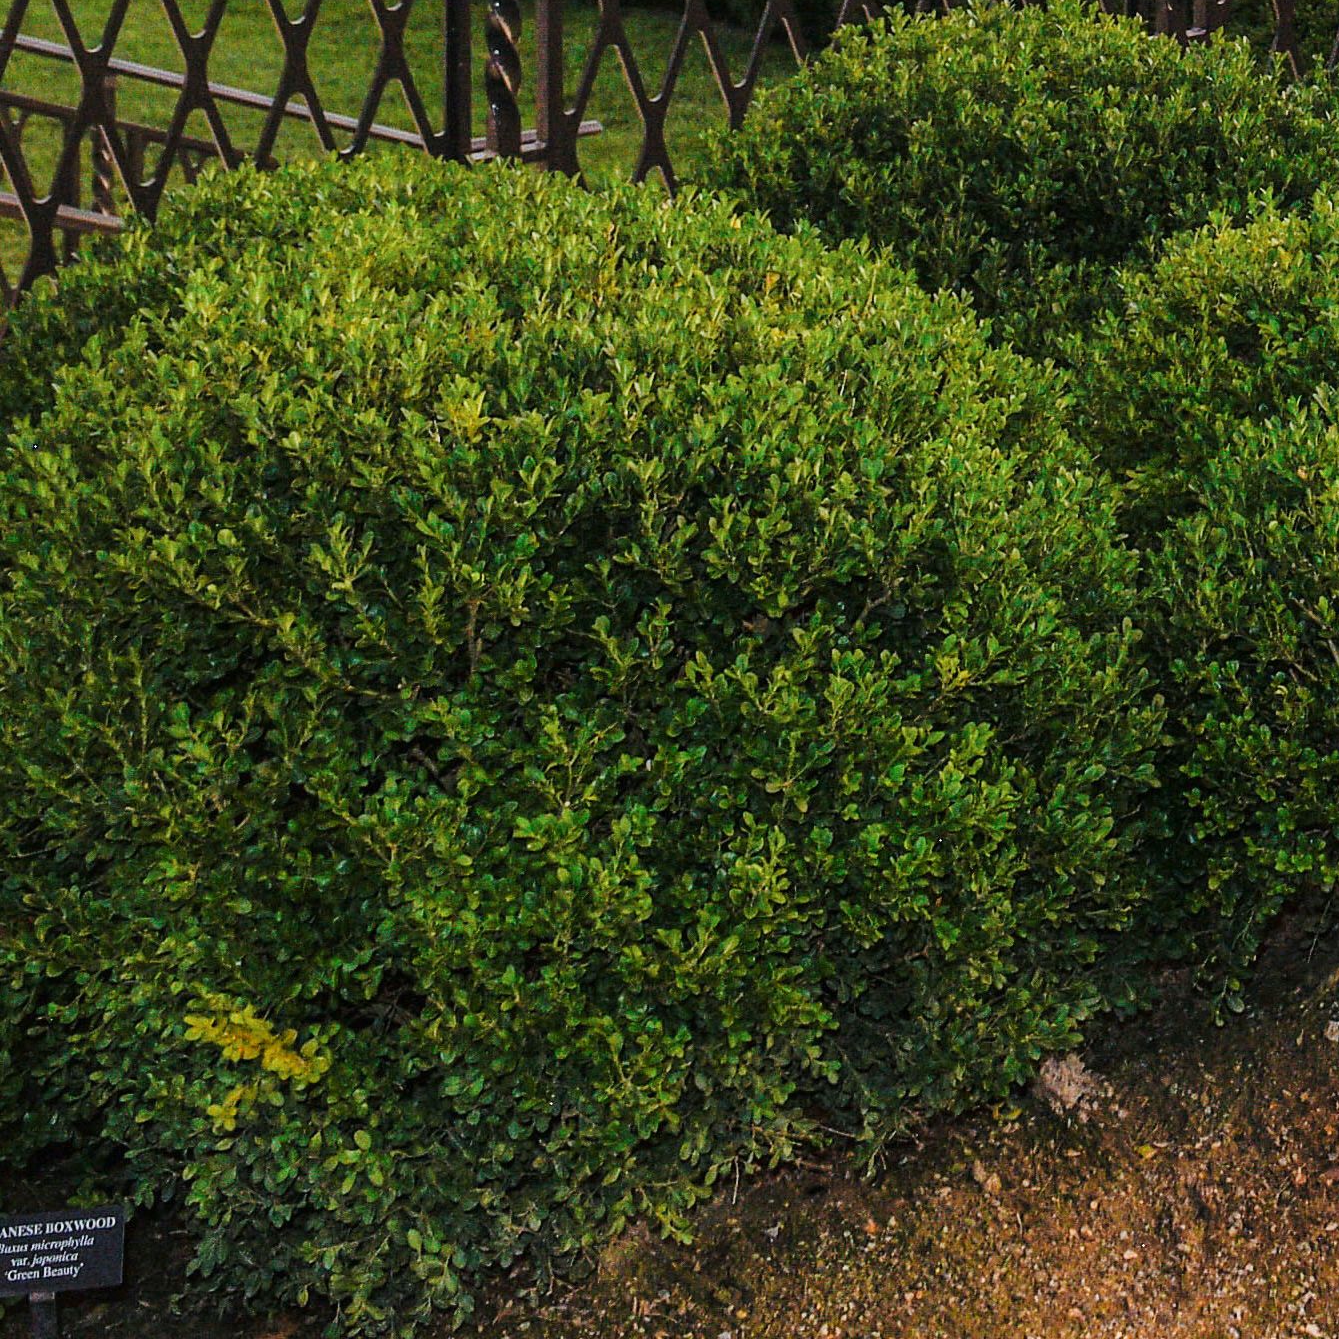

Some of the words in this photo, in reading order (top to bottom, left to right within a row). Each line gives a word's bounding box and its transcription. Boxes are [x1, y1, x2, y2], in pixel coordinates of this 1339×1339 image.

[45, 1216, 116, 1234] BOXWOOD
[30, 1234, 95, 1251] microphylla
[11, 1257, 31, 1267] var.
[30, 1251, 79, 1268] japonica
